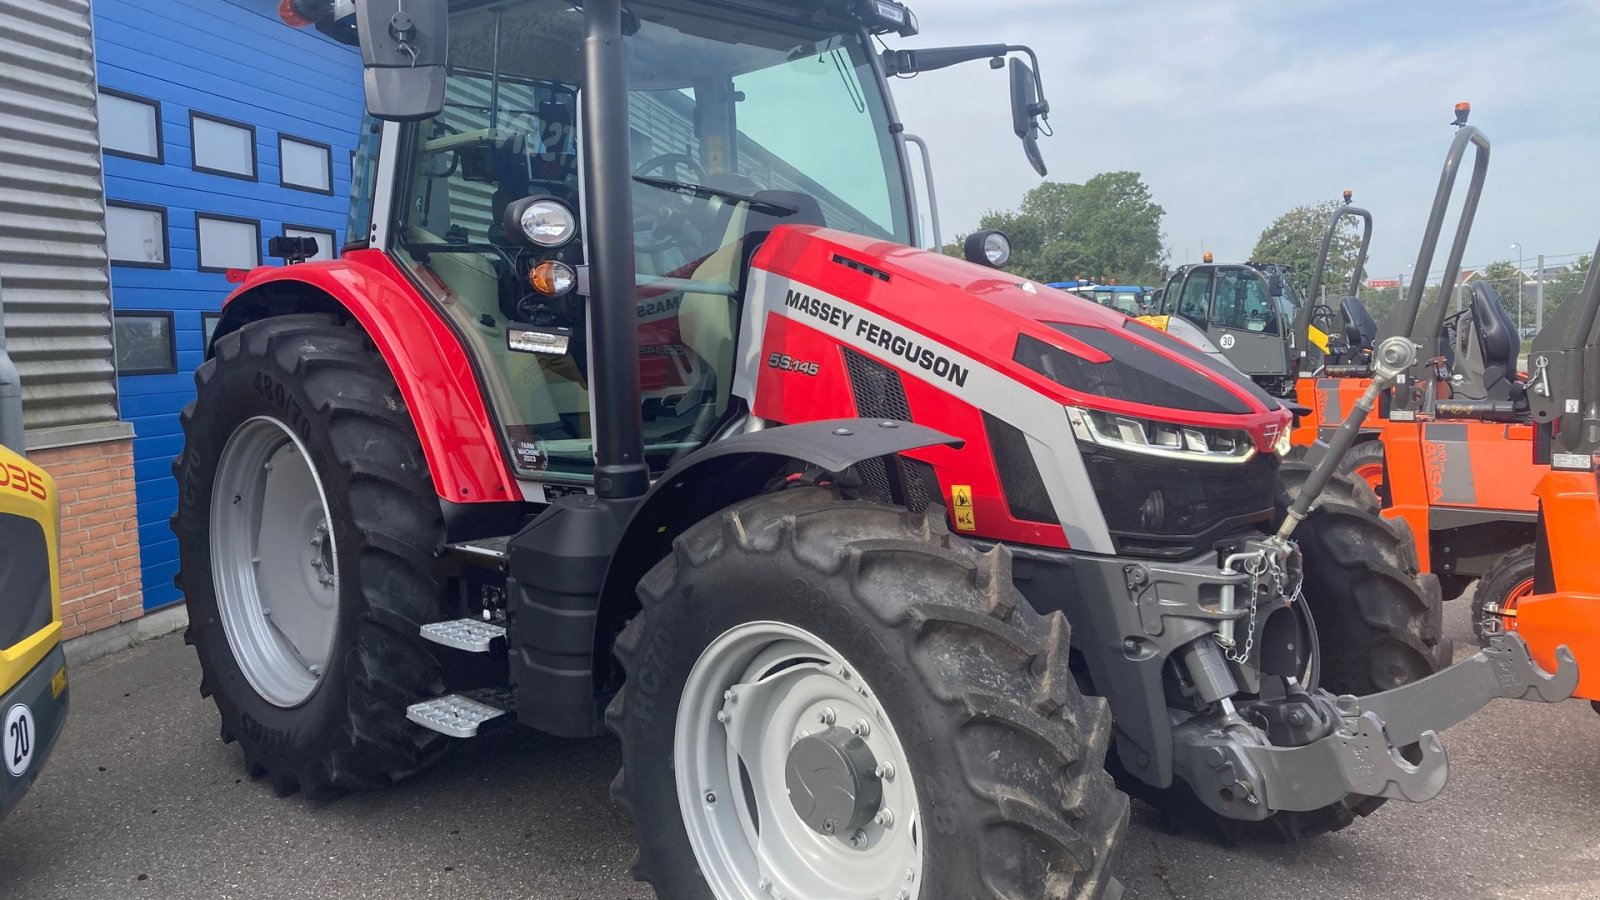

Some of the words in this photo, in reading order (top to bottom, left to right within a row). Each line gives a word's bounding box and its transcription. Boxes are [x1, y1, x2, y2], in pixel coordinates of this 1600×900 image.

[784, 289, 854, 330] MASSEY
[855, 318, 969, 388] FERGUSON
[1222, 336, 1232, 347] 30
[768, 352, 819, 376] 5S.145
[10, 714, 29, 767] 20
